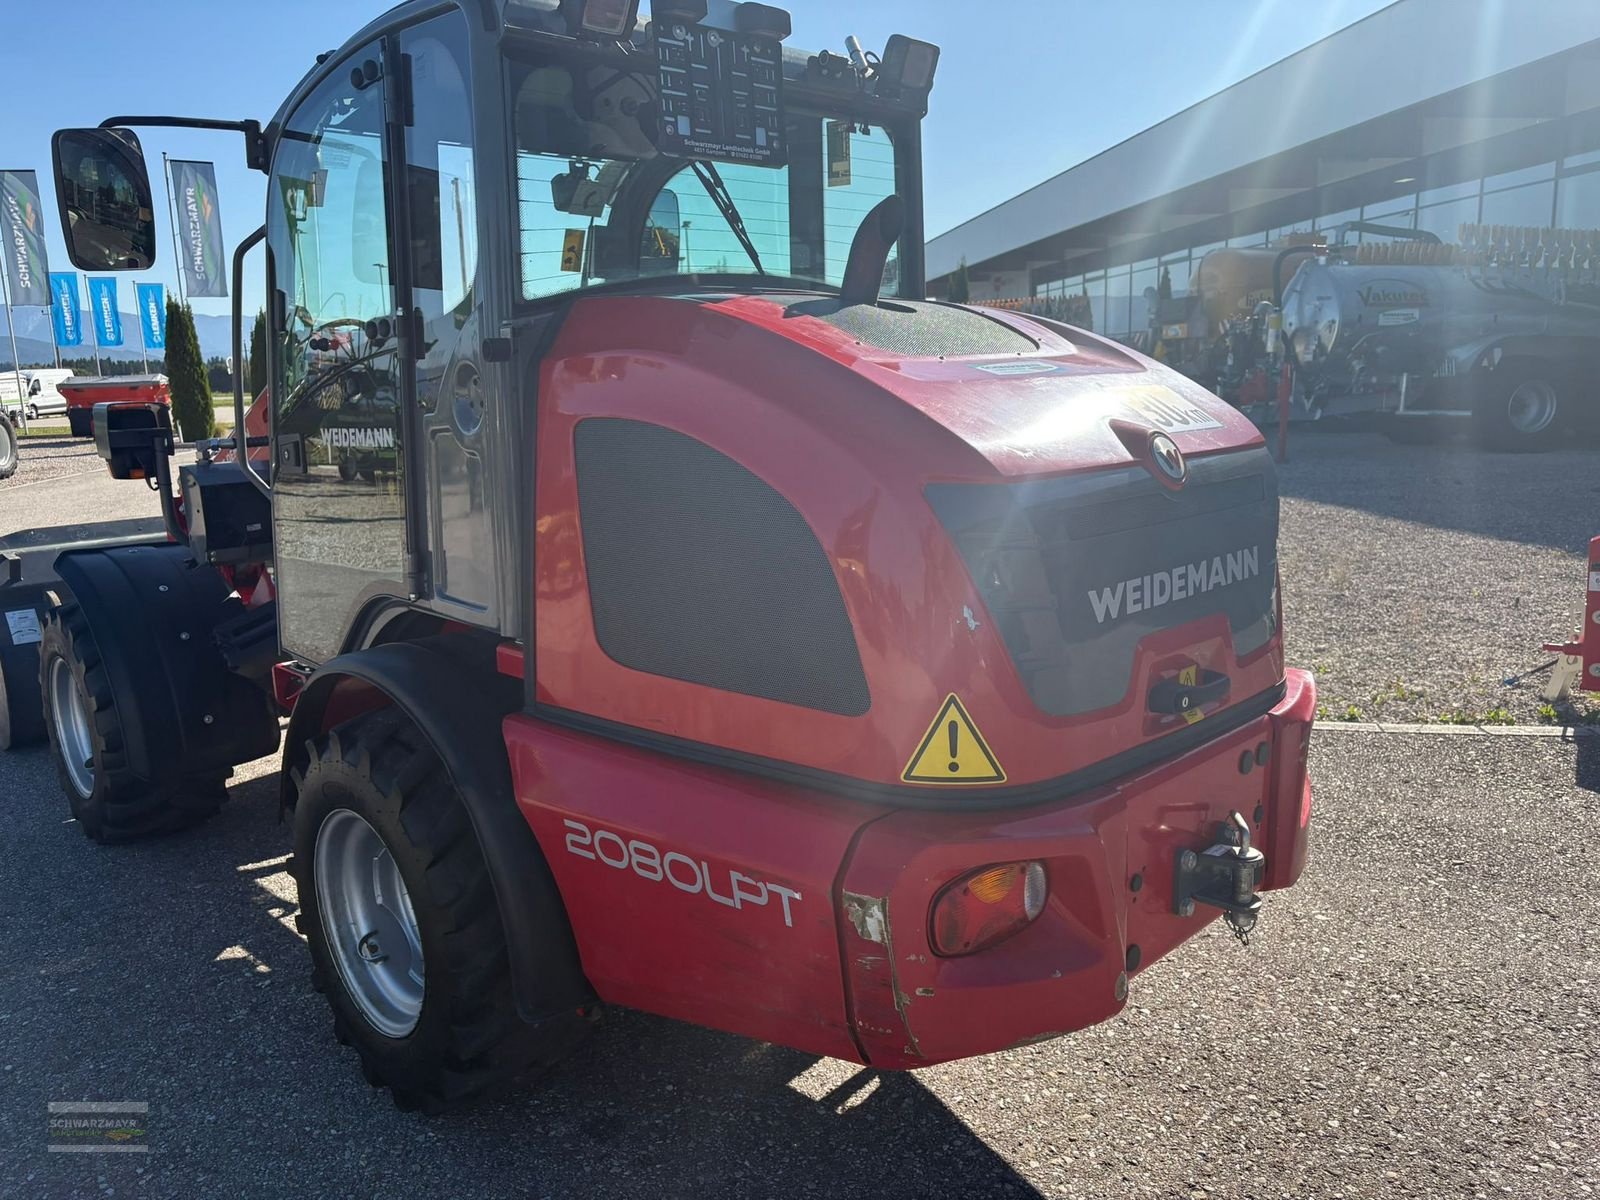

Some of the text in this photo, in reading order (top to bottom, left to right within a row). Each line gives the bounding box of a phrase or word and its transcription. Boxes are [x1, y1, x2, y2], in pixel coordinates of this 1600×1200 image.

[684, 139, 721, 150] Schwarzmayr
[722, 143, 754, 154] Landtechnik
[185, 187, 206, 280] SCHWARZMAYR
[320, 427, 394, 447] WEIDEMANN
[1088, 545, 1258, 624] WEIDEMANN
[563, 818, 802, 928] 2080LPT
